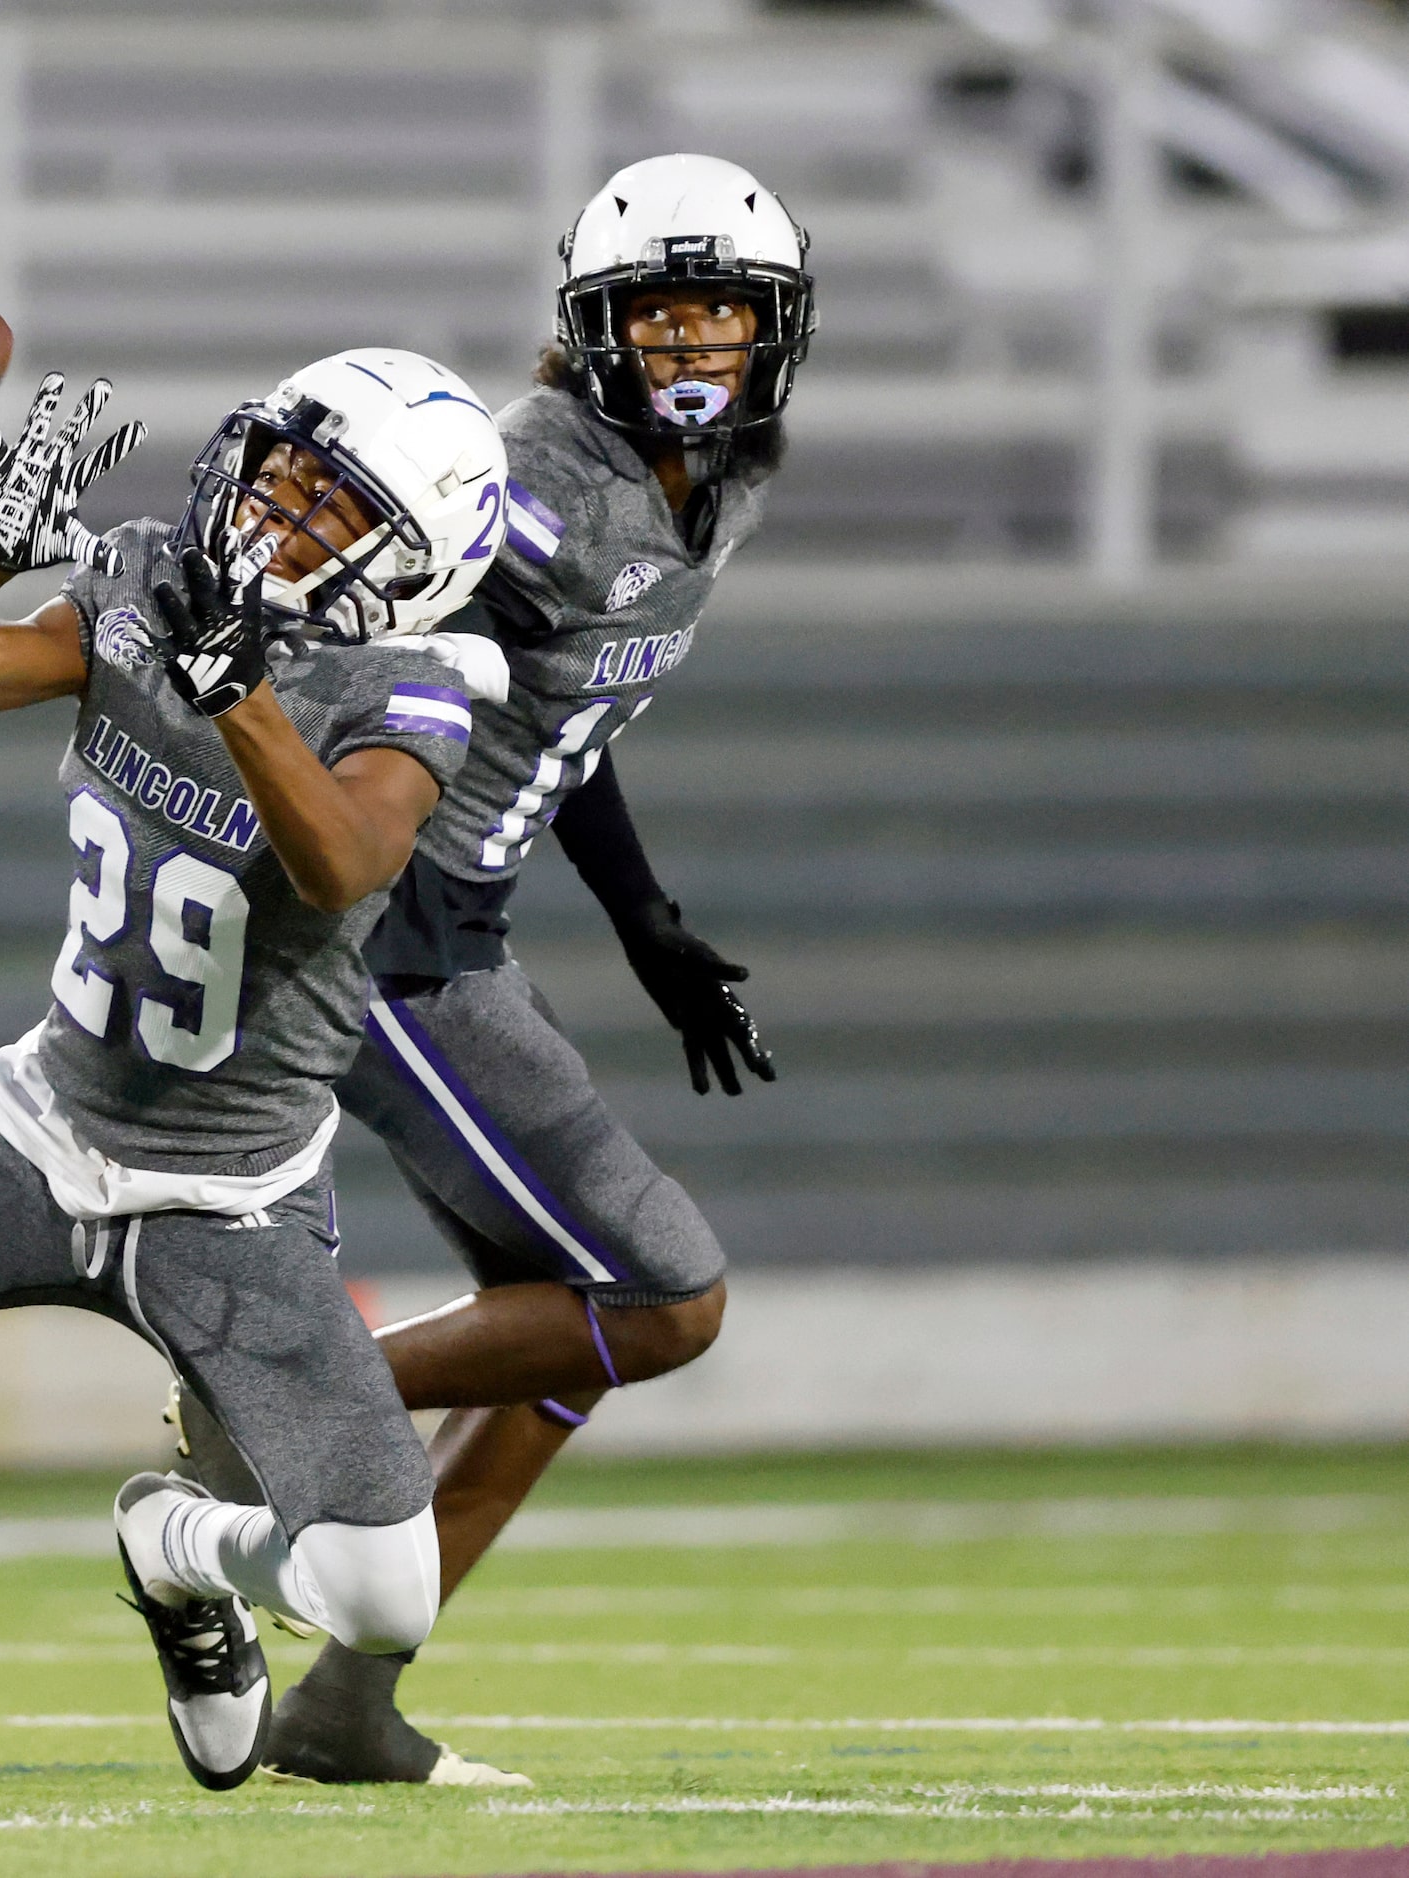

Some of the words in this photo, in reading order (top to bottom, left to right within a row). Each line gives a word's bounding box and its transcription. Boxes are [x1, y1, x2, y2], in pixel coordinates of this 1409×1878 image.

[83, 714, 262, 852] LINCOLN
[474, 690, 654, 873] 1
[50, 782, 252, 1075] 29
